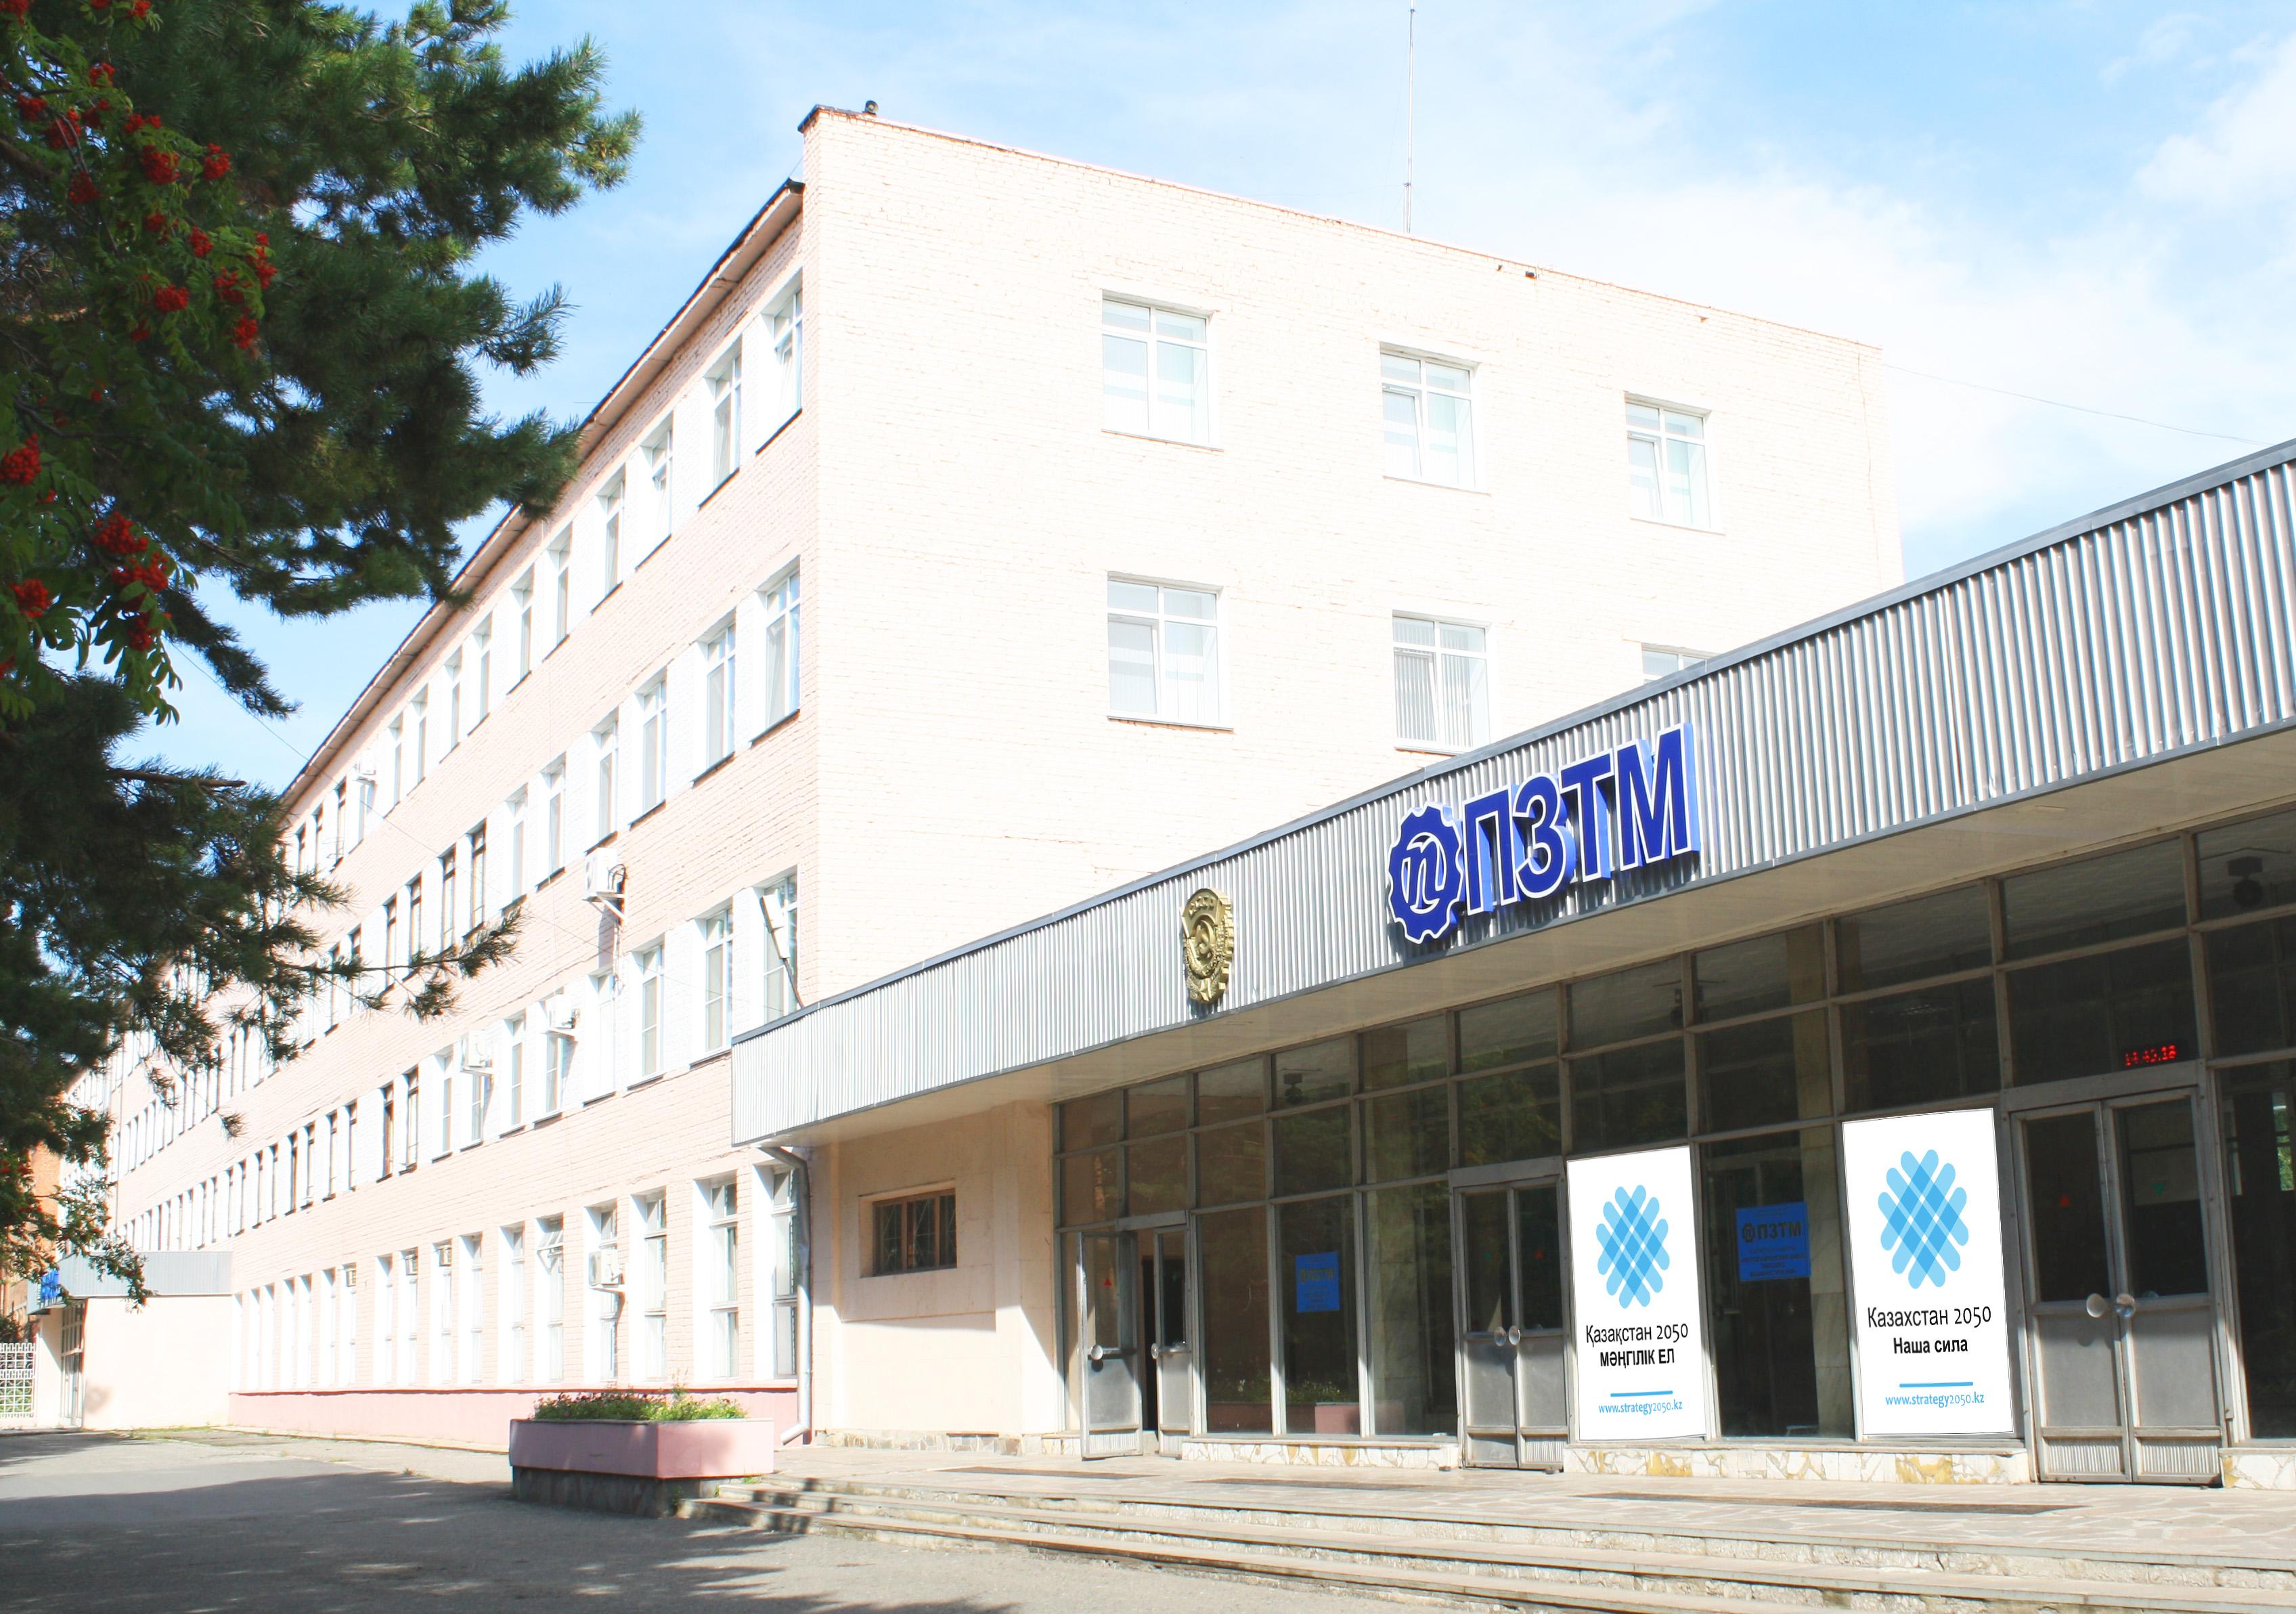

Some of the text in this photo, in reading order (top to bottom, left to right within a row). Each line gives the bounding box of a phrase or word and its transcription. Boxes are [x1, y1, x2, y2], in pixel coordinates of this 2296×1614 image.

[1462, 722, 1698, 916] ПЗТМ
[1757, 1221, 1802, 1240] ПЗТМ
[1868, 1306, 1991, 1328] Казахстан 2050
[1586, 1323, 1688, 1347] Қазақстан 2050
[1893, 1337, 1968, 1354] Наша сила
[1658, 1348, 1675, 1364] ЕЛ
[1598, 1399, 1683, 1415] www.strategy2050.kz
[1885, 1391, 1985, 1408] www.strategy2050.kz
